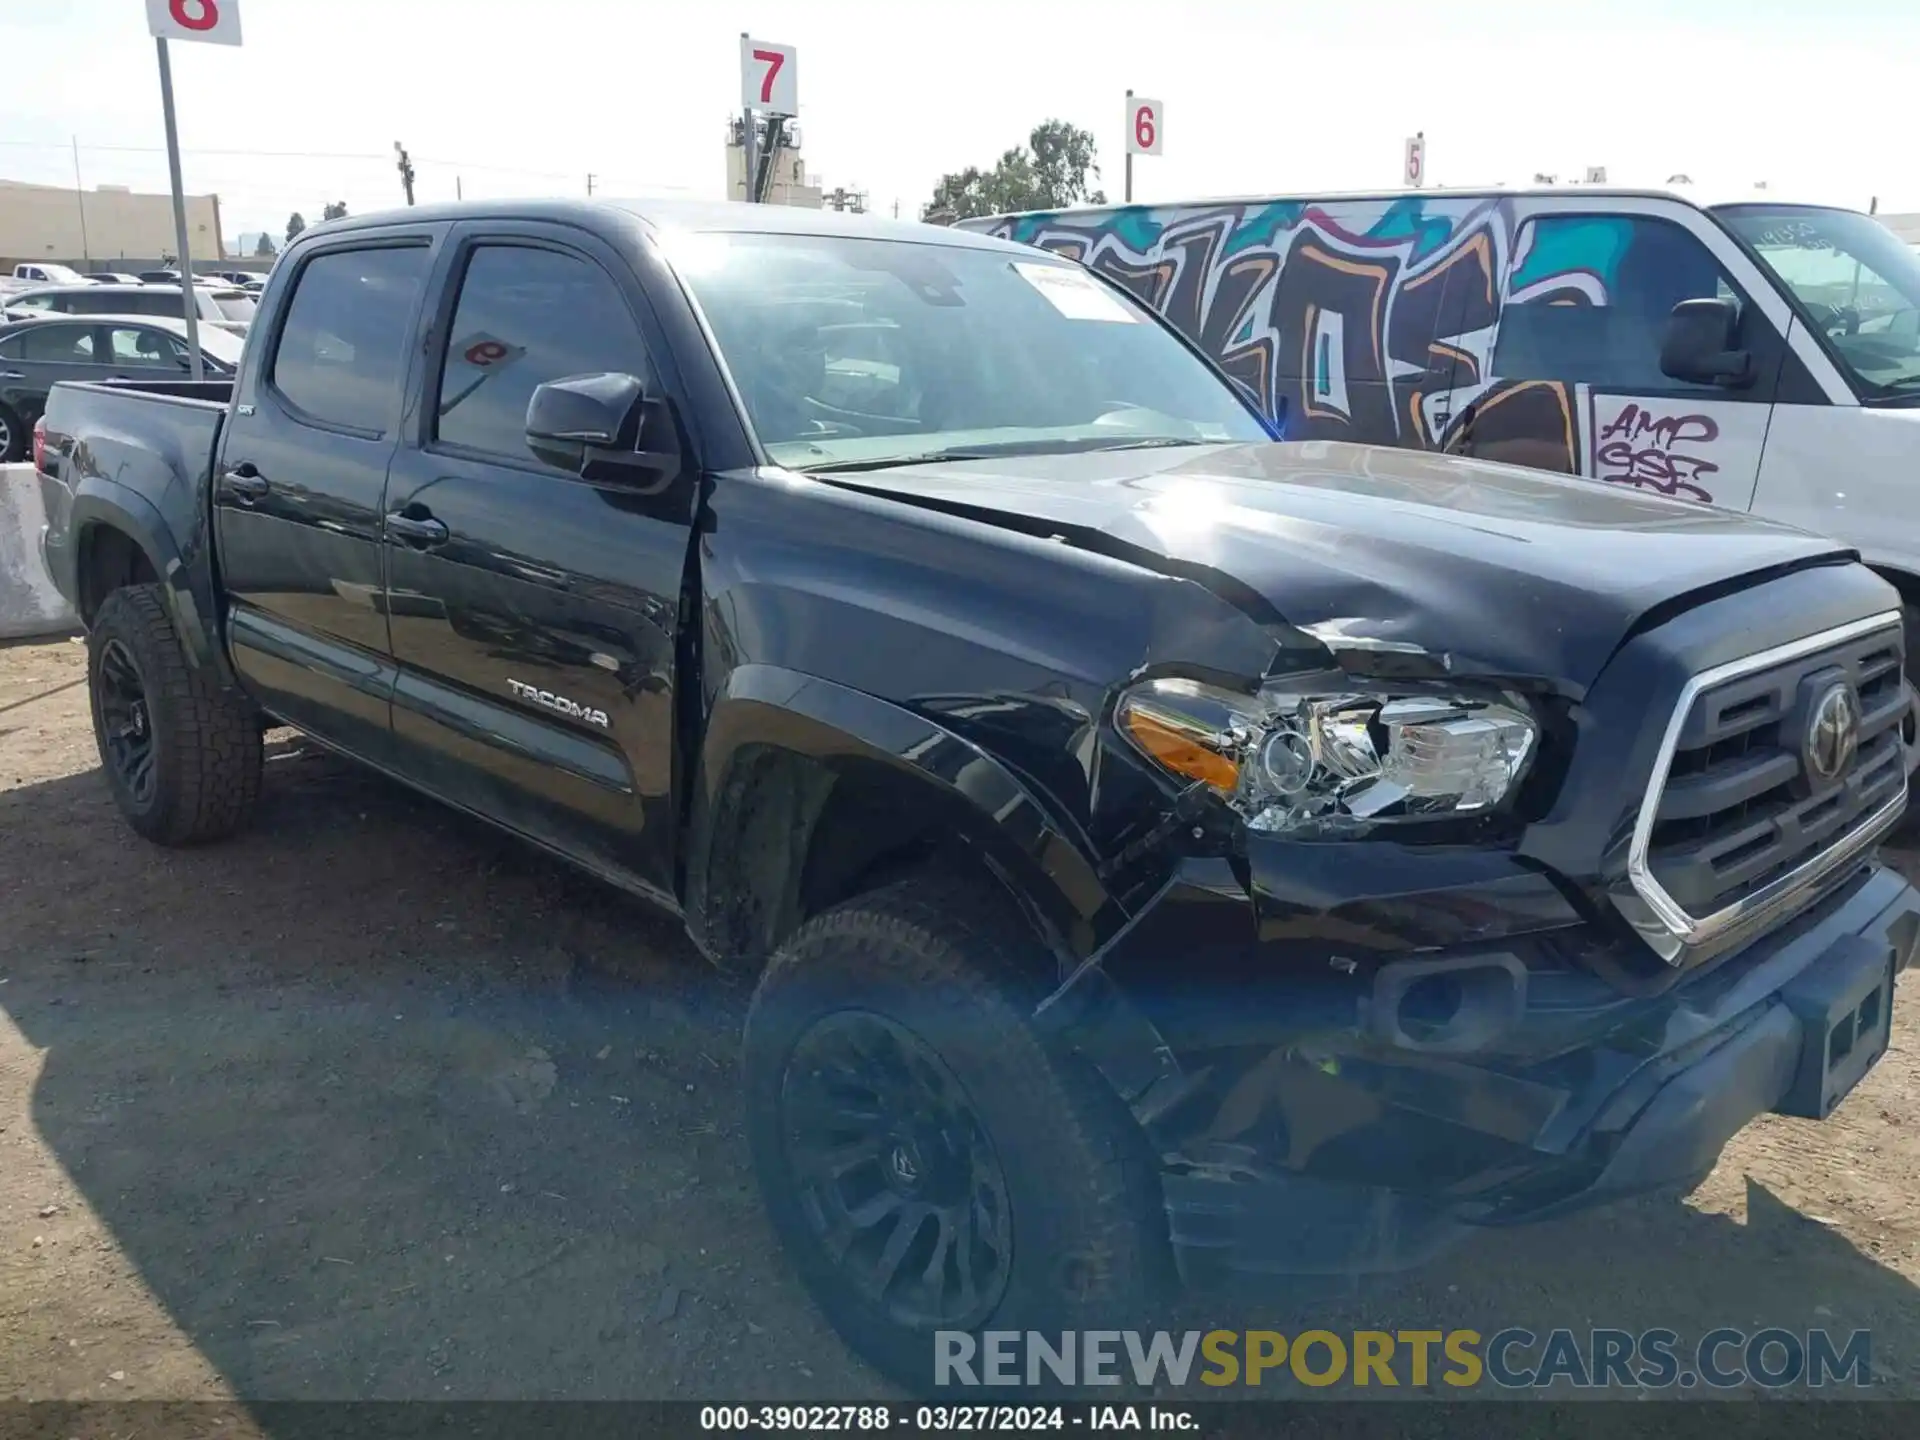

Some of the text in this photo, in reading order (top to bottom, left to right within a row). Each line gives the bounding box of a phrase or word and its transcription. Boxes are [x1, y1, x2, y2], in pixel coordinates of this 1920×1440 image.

[753, 50, 784, 103] 7
[1136, 106, 1154, 148] 6
[1409, 144, 1420, 180] 5
[506, 677, 609, 729] TACOMA
